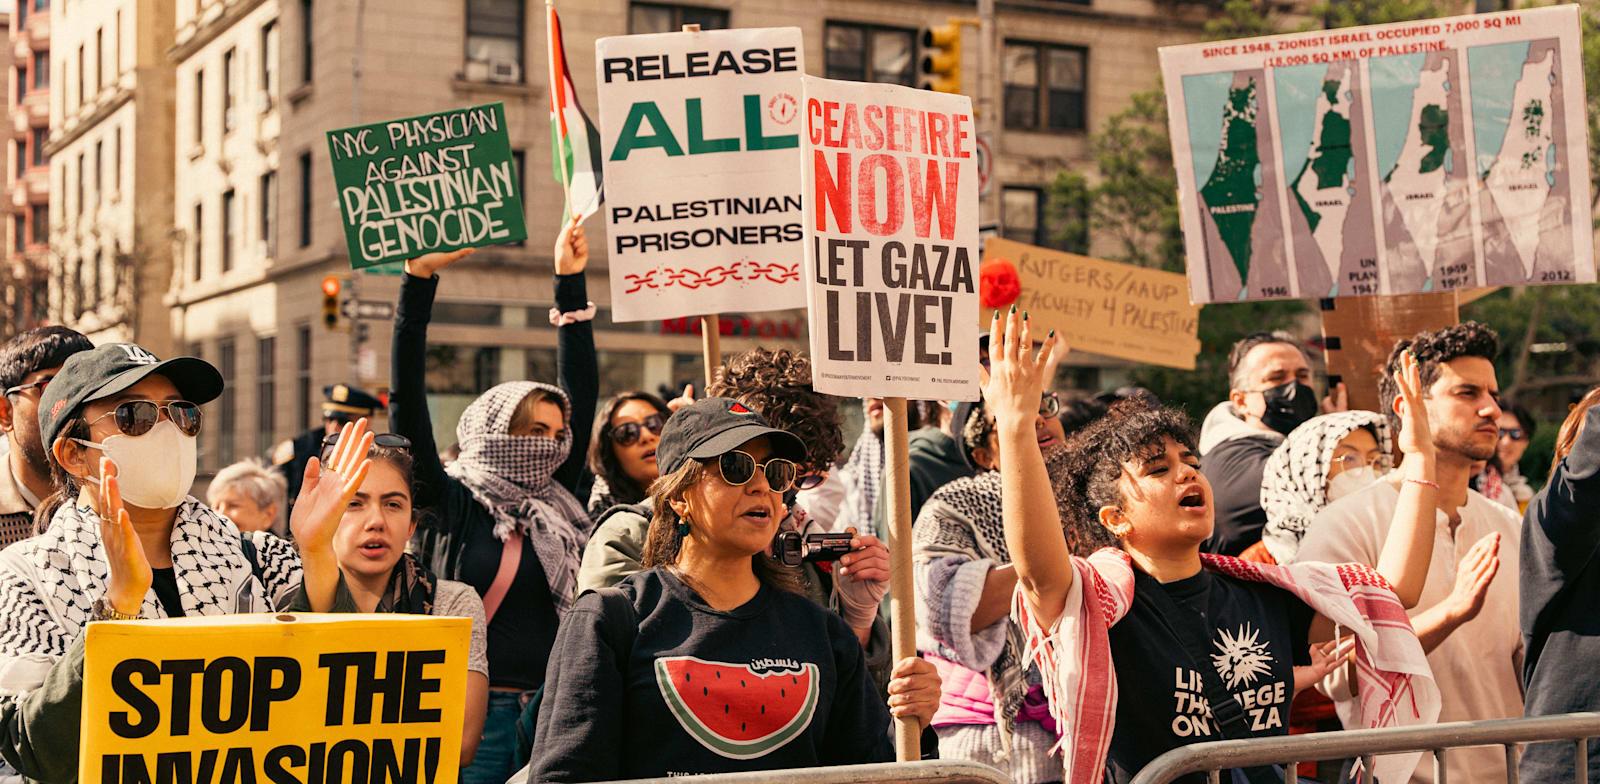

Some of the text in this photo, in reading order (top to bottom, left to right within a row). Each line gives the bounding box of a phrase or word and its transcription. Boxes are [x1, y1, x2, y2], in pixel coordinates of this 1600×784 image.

[1203, 15, 1522, 58] SINCE 1948, ZIONIST ISRAEL OCCUPIED 7,000 SQ MI
[604, 47, 797, 83] RELEASE
[1312, 52, 1329, 64] SQ
[1333, 50, 1356, 61] KM)
[1359, 48, 1373, 59] OF
[331, 108, 498, 160] NYC PHYSICIAN
[609, 94, 799, 161] ALL
[808, 97, 970, 159] CEASEFIRE
[365, 143, 475, 185] AGAINST
[342, 161, 514, 225] PALESTINIAN
[612, 194, 802, 224] PALESTINIAN
[814, 149, 960, 240] NOW
[1210, 203, 1256, 215] PALESTINE
[359, 201, 510, 261] GENOCIDE
[616, 223, 803, 254] PRISONERS
[815, 235, 975, 294] LET GAZA
[1019, 253, 1179, 301] RUTGERS/AAUP
[1349, 271, 1377, 281] PLAN
[1360, 258, 1377, 268] UN
[1542, 271, 1570, 281] 2012
[1261, 286, 1288, 297] 1946
[826, 290, 953, 365] LIVE!
[1102, 298, 1117, 327] 4
[751, 658, 800, 670] فلسطين
[1175, 667, 1204, 693] LIF
[108, 650, 446, 739] STOP THE
[1233, 681, 1286, 710] IEGE
[1172, 715, 1211, 737] ON
